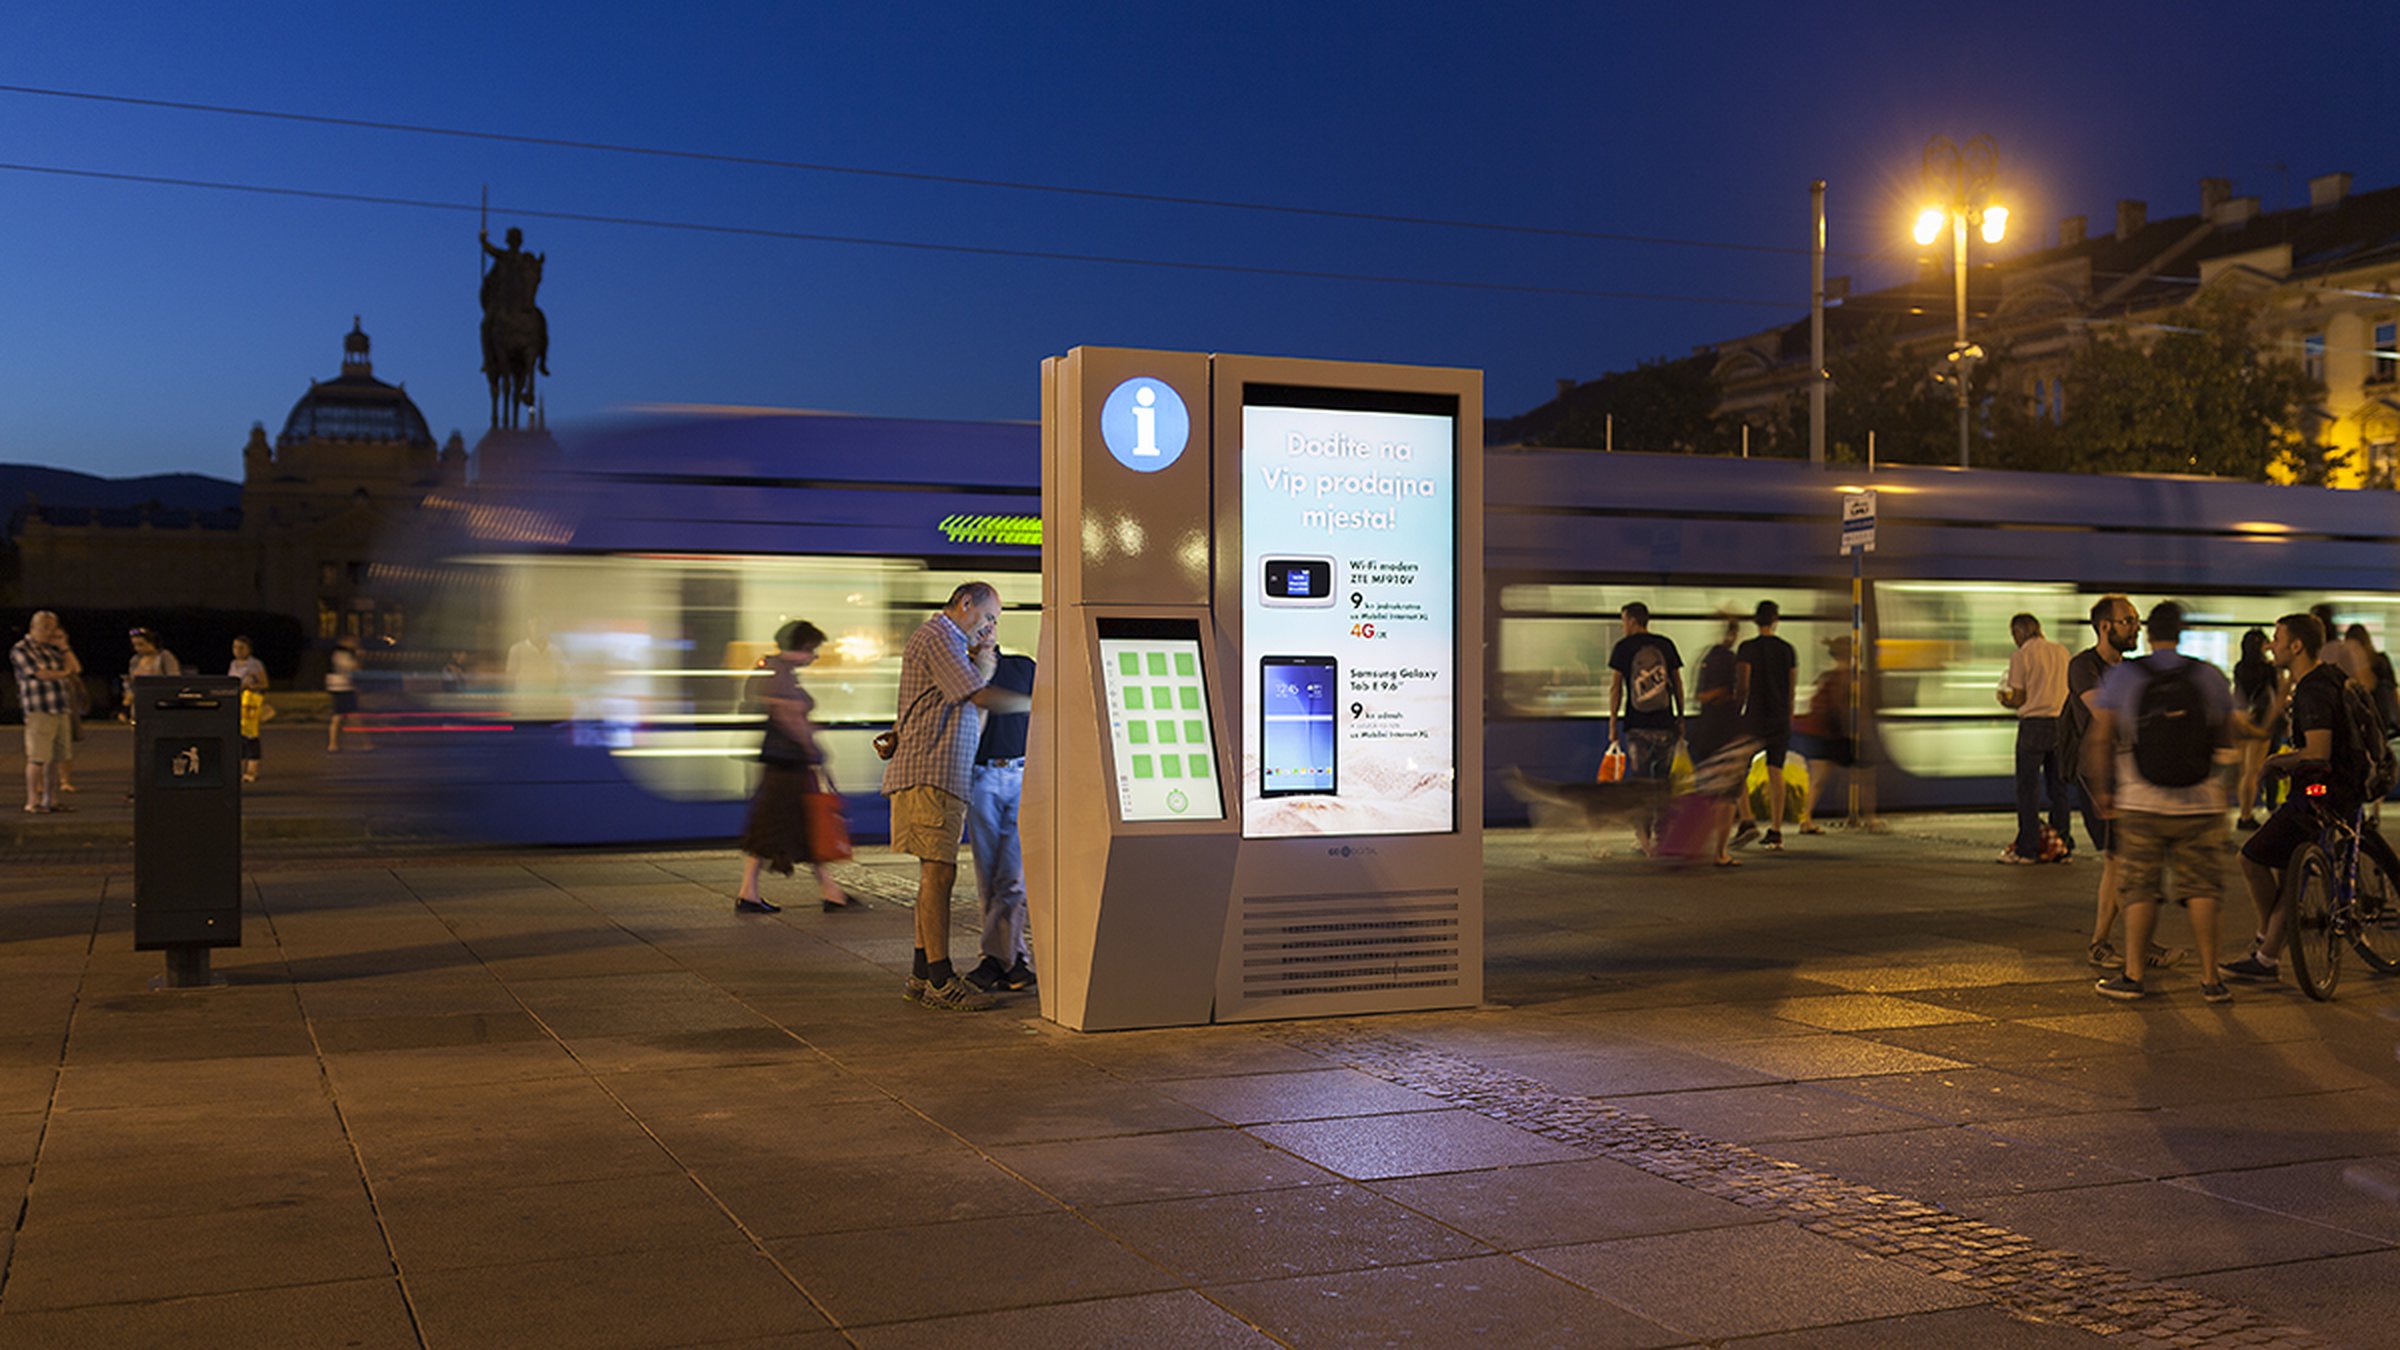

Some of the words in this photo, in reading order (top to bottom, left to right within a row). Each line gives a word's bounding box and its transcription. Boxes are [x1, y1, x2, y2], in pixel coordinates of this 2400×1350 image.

[1132, 387, 1160, 456] i
[1286, 431, 1371, 458] Dodite
[1380, 443, 1412, 460] na
[1262, 466, 1307, 498] Vip
[1316, 469, 1435, 502] prodajna
[1302, 503, 1396, 536] mjesta!
[1380, 561, 1418, 572] modem
[1351, 574, 1367, 584] ZTE
[1350, 591, 1363, 609] 9
[1350, 623, 1375, 639] 4G
[1350, 668, 1397, 680] Samsung
[1399, 667, 1438, 681] Galaxy
[1350, 681, 1369, 691] Tab
[1372, 681, 1378, 691] E
[1350, 701, 1363, 719] 9
